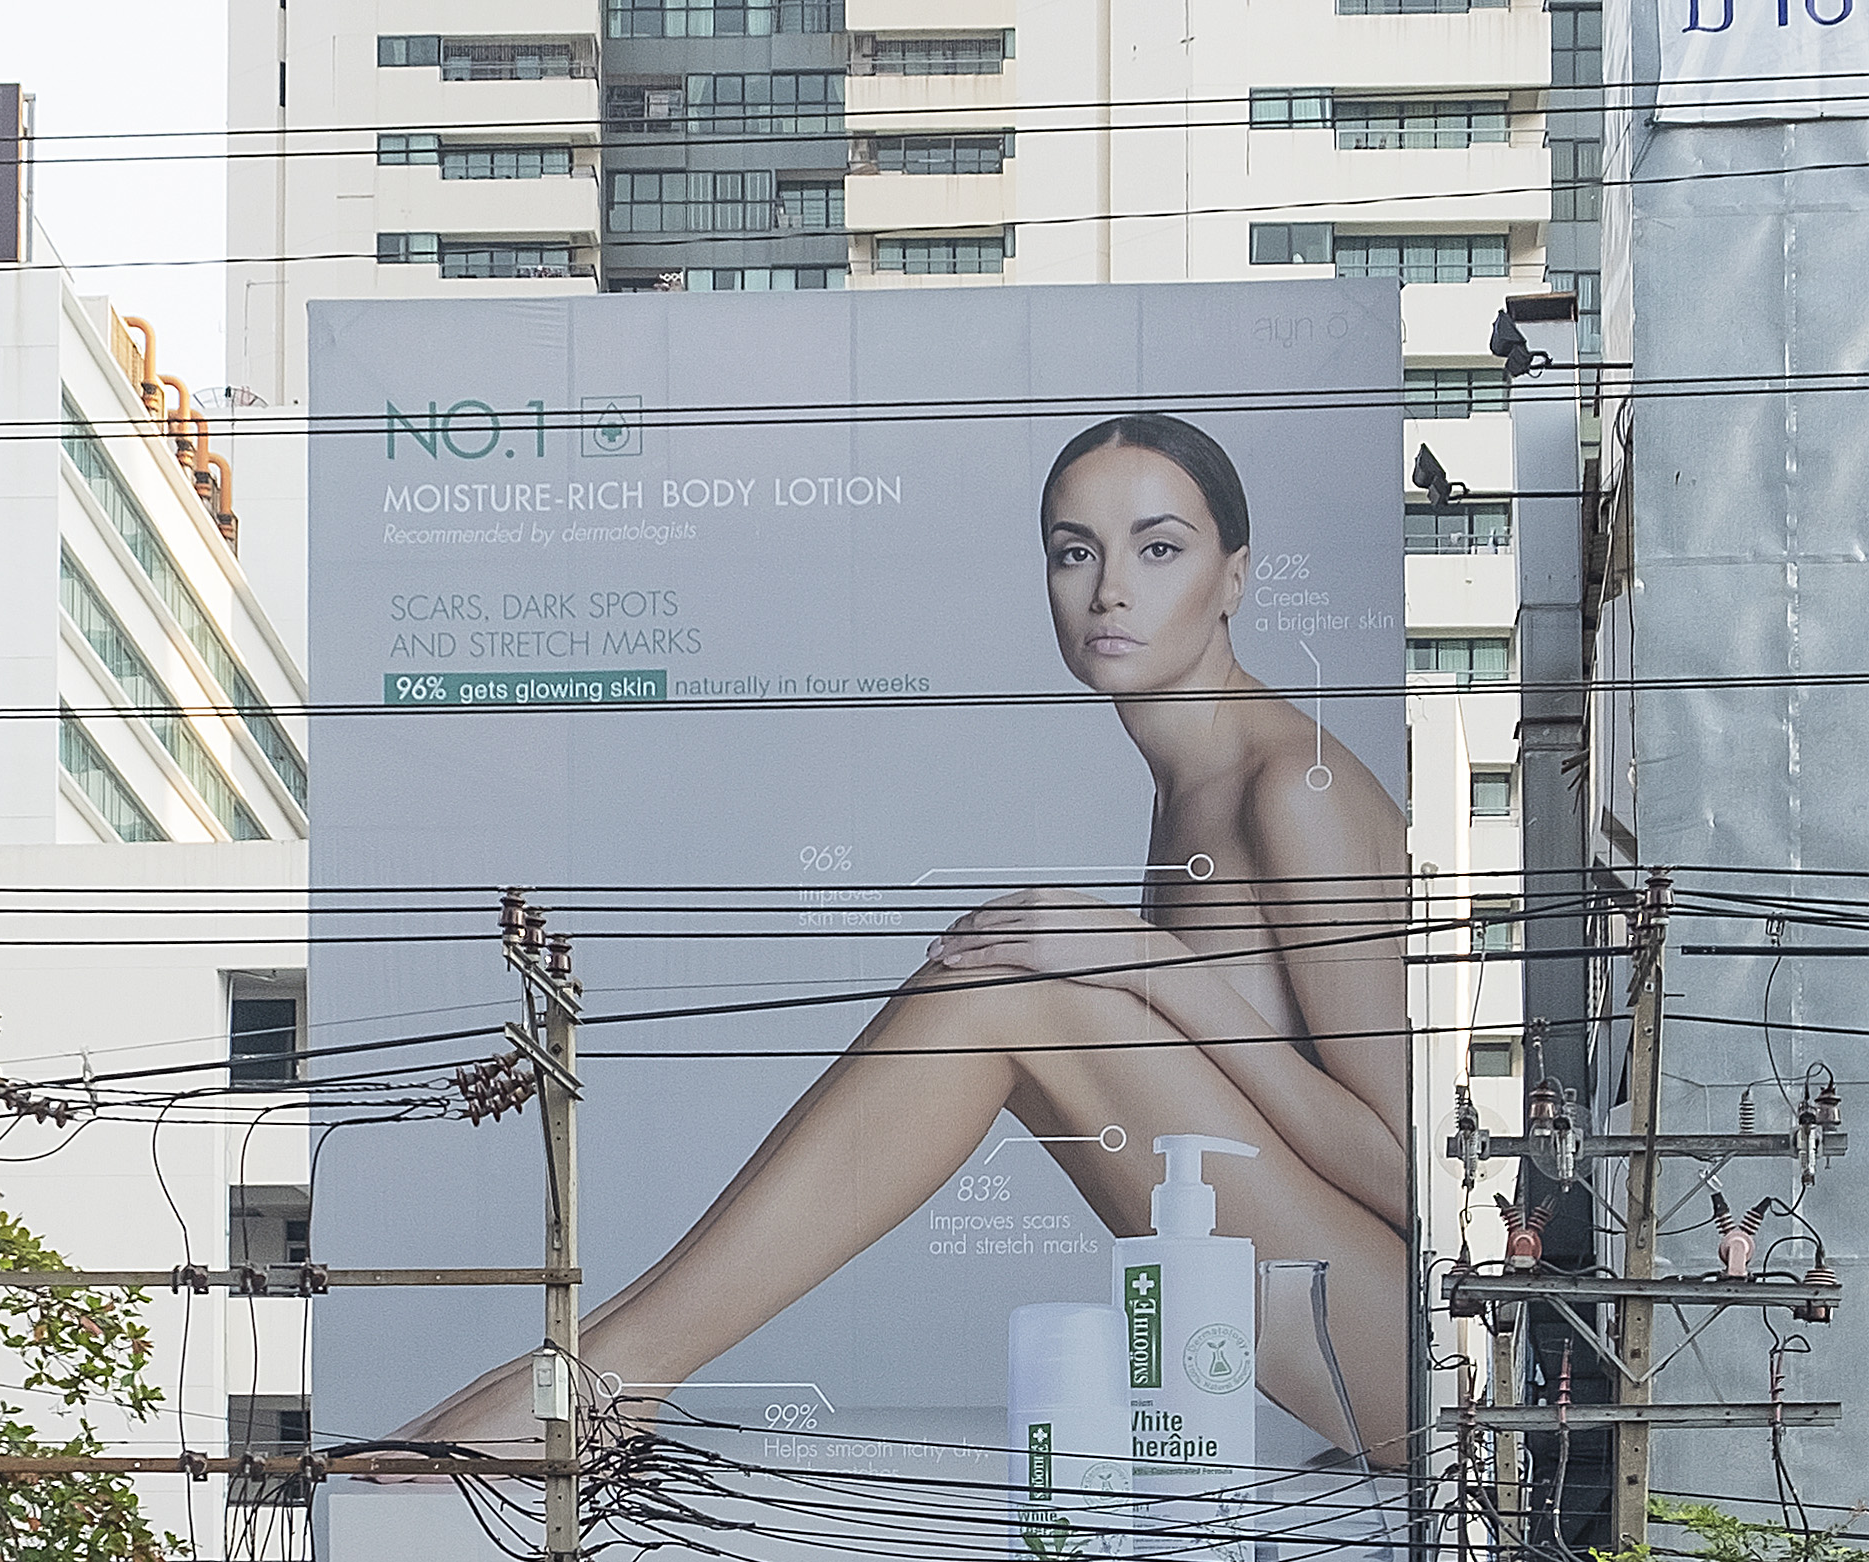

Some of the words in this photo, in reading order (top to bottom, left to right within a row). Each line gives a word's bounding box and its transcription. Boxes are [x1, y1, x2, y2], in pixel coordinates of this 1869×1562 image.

[385, 400, 545, 460] NO.1
[384, 482, 643, 513] MOISTURE-RICH
[662, 478, 755, 507] BODY
[775, 475, 902, 506] LOTION
[384, 524, 523, 545] Recommended
[530, 522, 556, 547] by
[562, 520, 698, 546] dermatologists
[1255, 554, 1311, 581] 62%
[391, 594, 489, 622] SCARS,
[503, 592, 576, 620] DARK
[589, 590, 679, 618] SPOTS
[1255, 586, 1330, 607] Creates
[1255, 617, 1270, 633] a
[1277, 611, 1350, 637] brighter
[1358, 609, 1395, 631] skin
[390, 632, 456, 659] AND
[469, 629, 590, 658] STRETCH
[602, 627, 702, 656] MARKS
[395, 675, 446, 701] 96%
[459, 679, 508, 703] gets
[515, 676, 603, 702] glowing
[609, 675, 657, 697] skin
[676, 675, 771, 699] naturally
[779, 675, 797, 694] in
[804, 674, 850, 693] four
[857, 673, 931, 693] weeks
[799, 845, 853, 872] 96%
[798, 907, 834, 926] skin
[842, 908, 903, 926] texture
[957, 1175, 1012, 1202] 83%
[930, 1210, 1016, 1235] Improves
[1022, 1213, 1072, 1230] scars
[929, 1234, 968, 1255] and
[976, 1234, 1035, 1255] stretch
[1043, 1234, 1099, 1255] marks
[764, 1403, 820, 1429] 99%
[764, 1437, 819, 1463] Helps
[826, 1439, 894, 1459] smooth
[903, 1438, 946, 1464] itchy
[1132, 1433, 1218, 1461] herâpie
